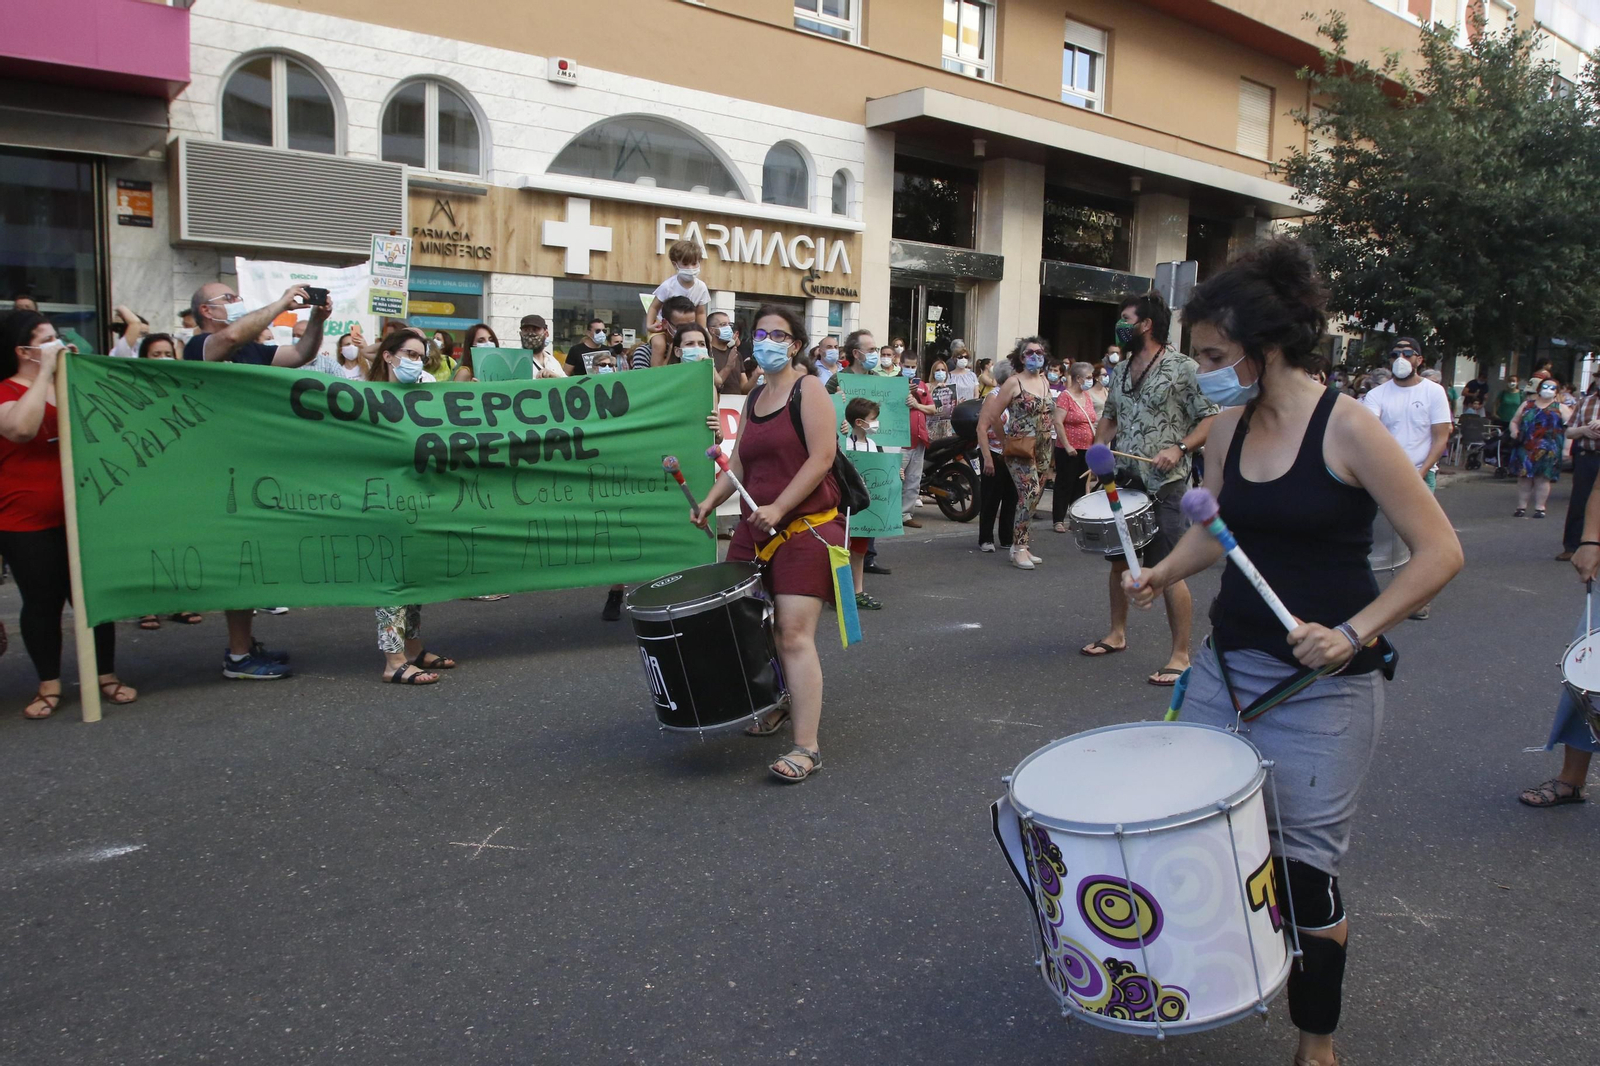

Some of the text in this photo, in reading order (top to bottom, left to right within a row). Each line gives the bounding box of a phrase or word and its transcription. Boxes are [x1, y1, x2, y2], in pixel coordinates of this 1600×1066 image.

[413, 227, 470, 241] FARMACIA
[420, 241, 492, 259] MINISTERIOS
[656, 217, 852, 274] FARMACIA
[380, 278, 404, 288] NEAE
[811, 285, 858, 297] NUTRIFARMA
[290, 376, 629, 427] CONCEPCIÓN
[414, 427, 599, 473] ARENAL
[362, 477, 435, 525] Elegir
[451, 474, 494, 512] Mi
[151, 507, 642, 593] NO AL CIERRE DE AULAS
